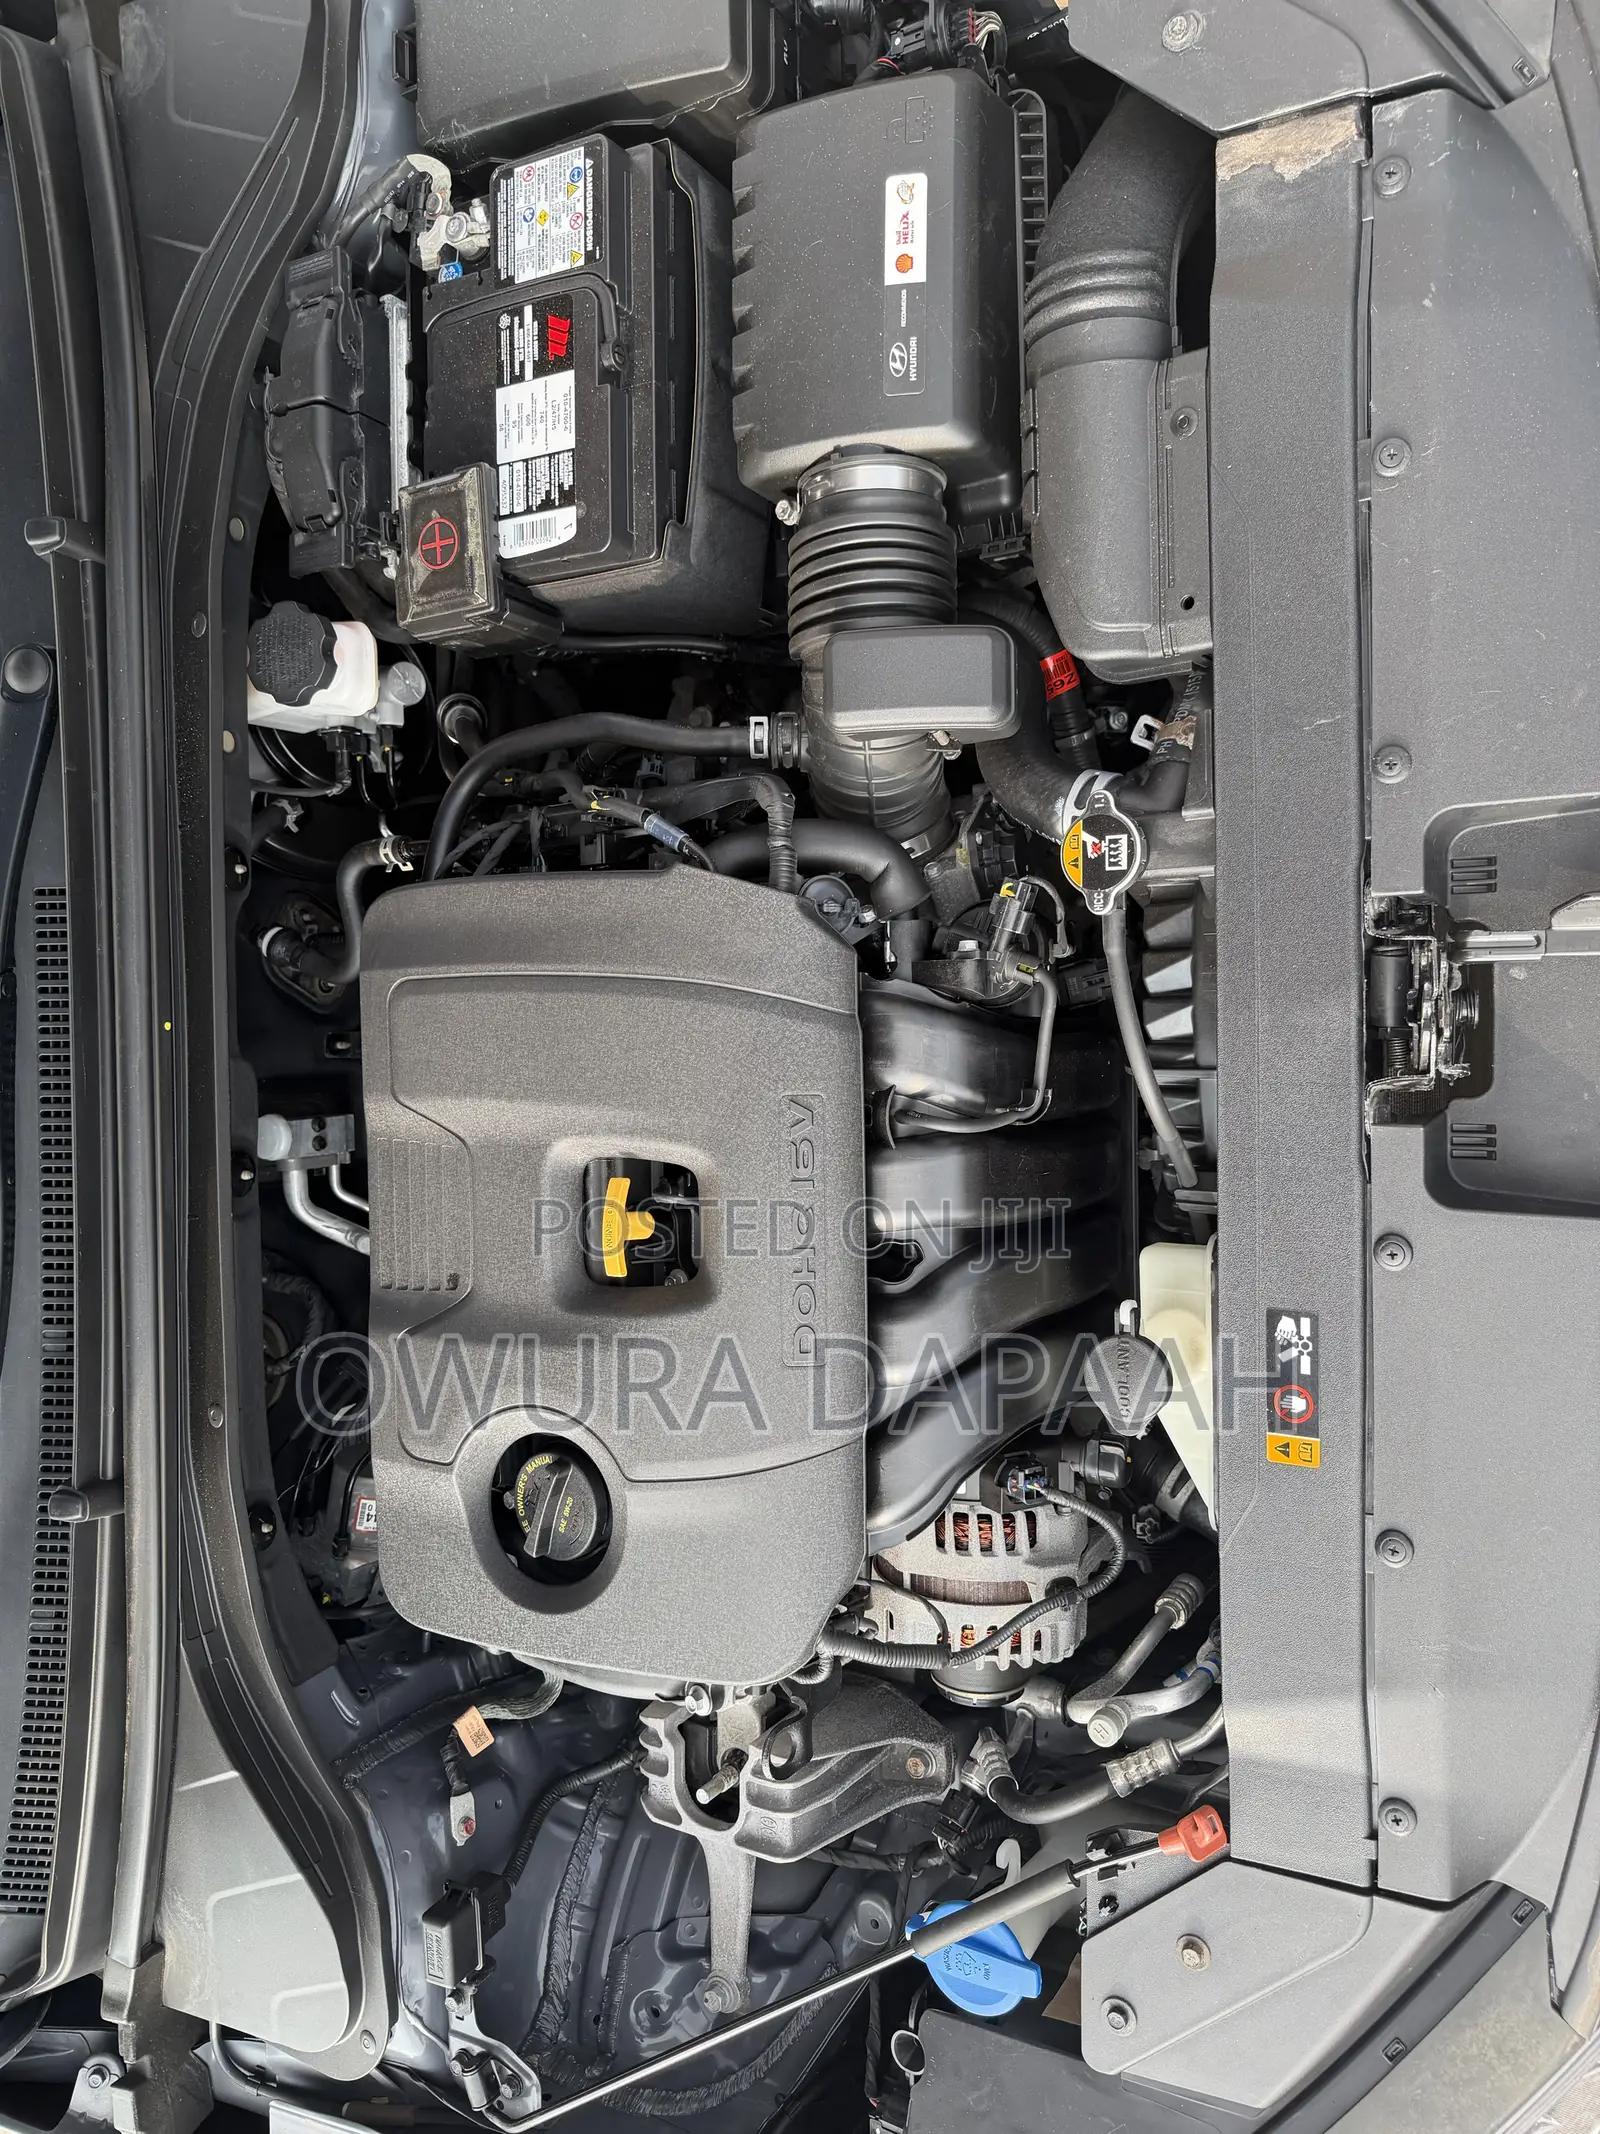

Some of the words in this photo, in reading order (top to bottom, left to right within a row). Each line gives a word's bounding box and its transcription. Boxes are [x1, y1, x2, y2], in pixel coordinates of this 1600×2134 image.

[898, 211, 910, 245] HELIX
[909, 336, 918, 382] HYUNDAI
[792, 1206, 817, 1362] DOHC
[1117, 1340, 1131, 1418] COOLANT
[516, 1472, 528, 1517] OWNER'S
[558, 1518, 568, 1533] SAE
